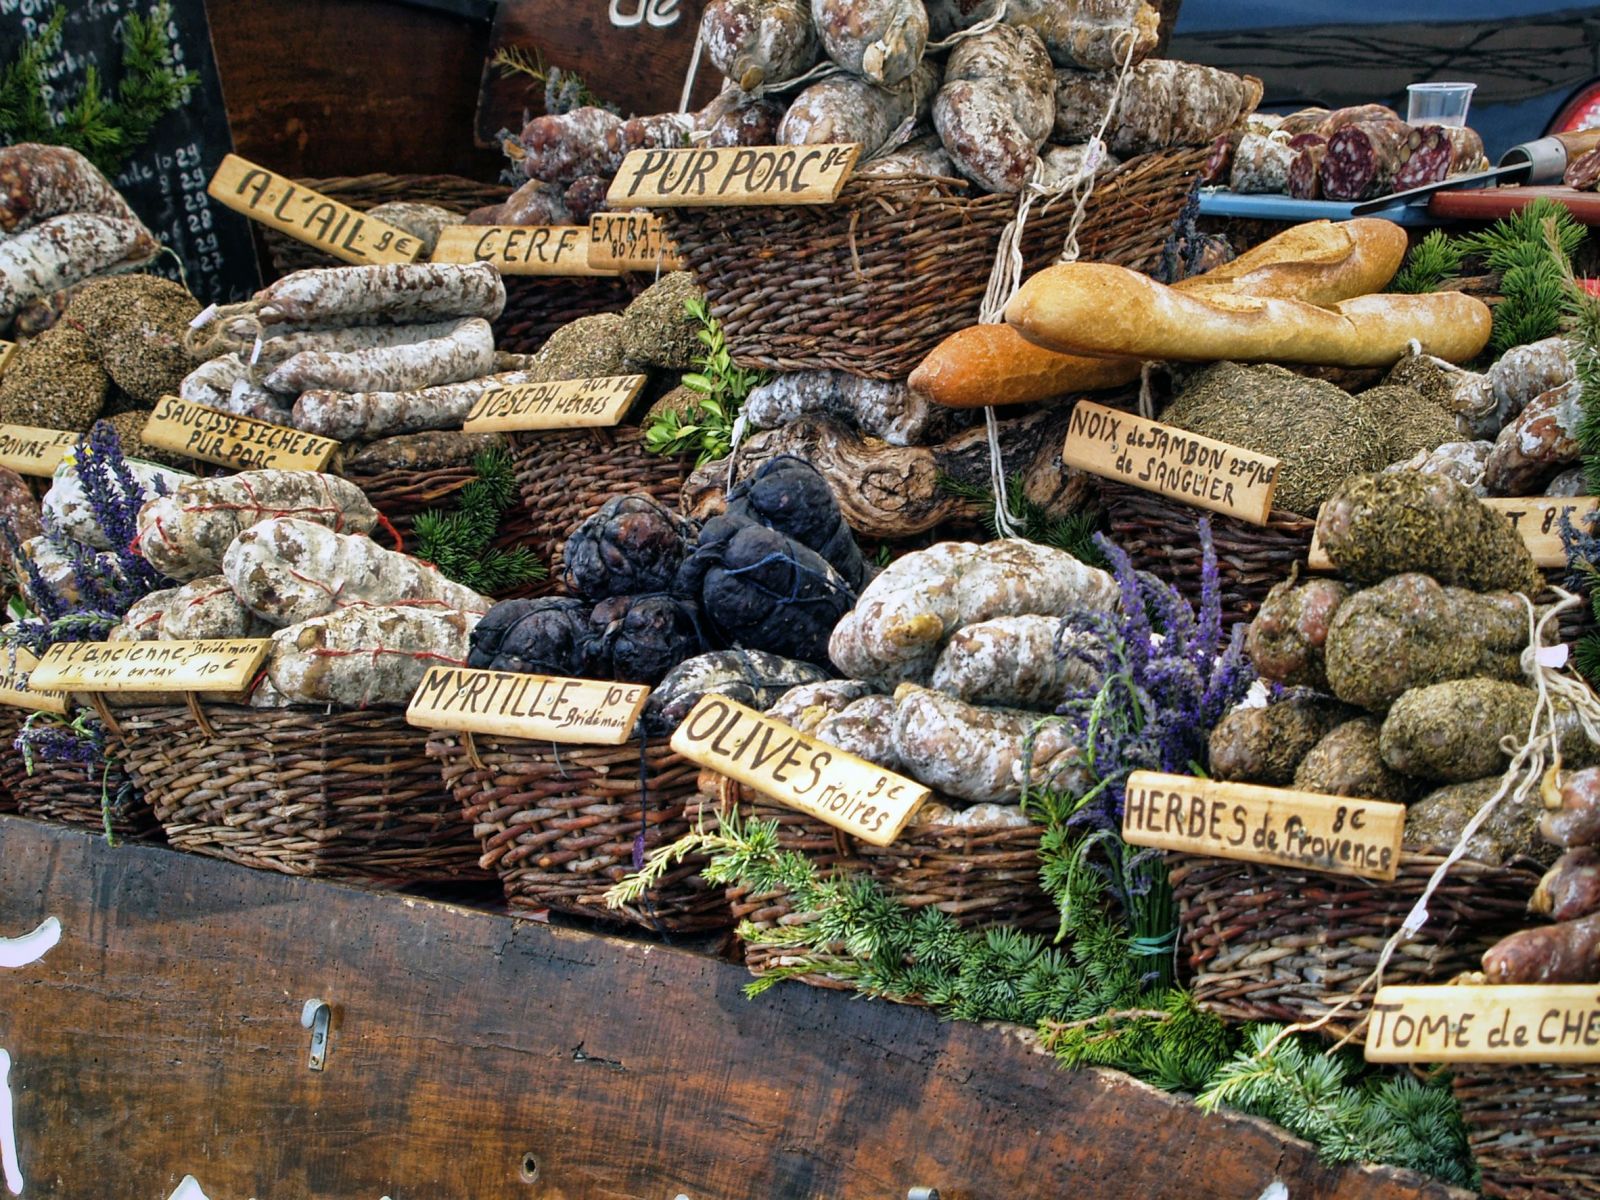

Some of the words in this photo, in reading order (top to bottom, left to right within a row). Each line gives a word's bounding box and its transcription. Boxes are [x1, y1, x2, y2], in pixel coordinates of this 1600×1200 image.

[176, 143, 201, 167] 29
[627, 149, 720, 197] PUR
[717, 149, 822, 195] PORC
[180, 167, 206, 190] 29
[236, 169, 272, 209] A
[184, 191, 209, 212] 29
[187, 208, 212, 233] 28
[195, 232, 218, 252] 29
[201, 251, 224, 272] 27
[474, 228, 579, 263] CERF
[465, 384, 560, 422] JOSEPH
[551, 394, 611, 415] HERBES
[156, 399, 242, 438] SAUCISSE
[241, 424, 305, 455] SECHE
[1070, 407, 1122, 442] NOIX
[1126, 424, 1146, 446] de
[1143, 426, 1228, 471] JAMBON
[185, 429, 226, 459] PUR
[227, 441, 277, 469] PORC
[1115, 447, 1133, 475] de
[1138, 456, 1235, 508] SANGLIER
[49, 643, 68, 663] A
[414, 669, 582, 722] MYRTILLE
[555, 706, 602, 729] Bridé
[686, 699, 833, 794] OLIVES
[816, 782, 890, 833] noires
[1125, 787, 1248, 847] HERBES
[1252, 811, 1279, 850] de
[1284, 814, 1393, 872] Provence
[1374, 1002, 1476, 1050] TOME
[1486, 1007, 1530, 1048] de
